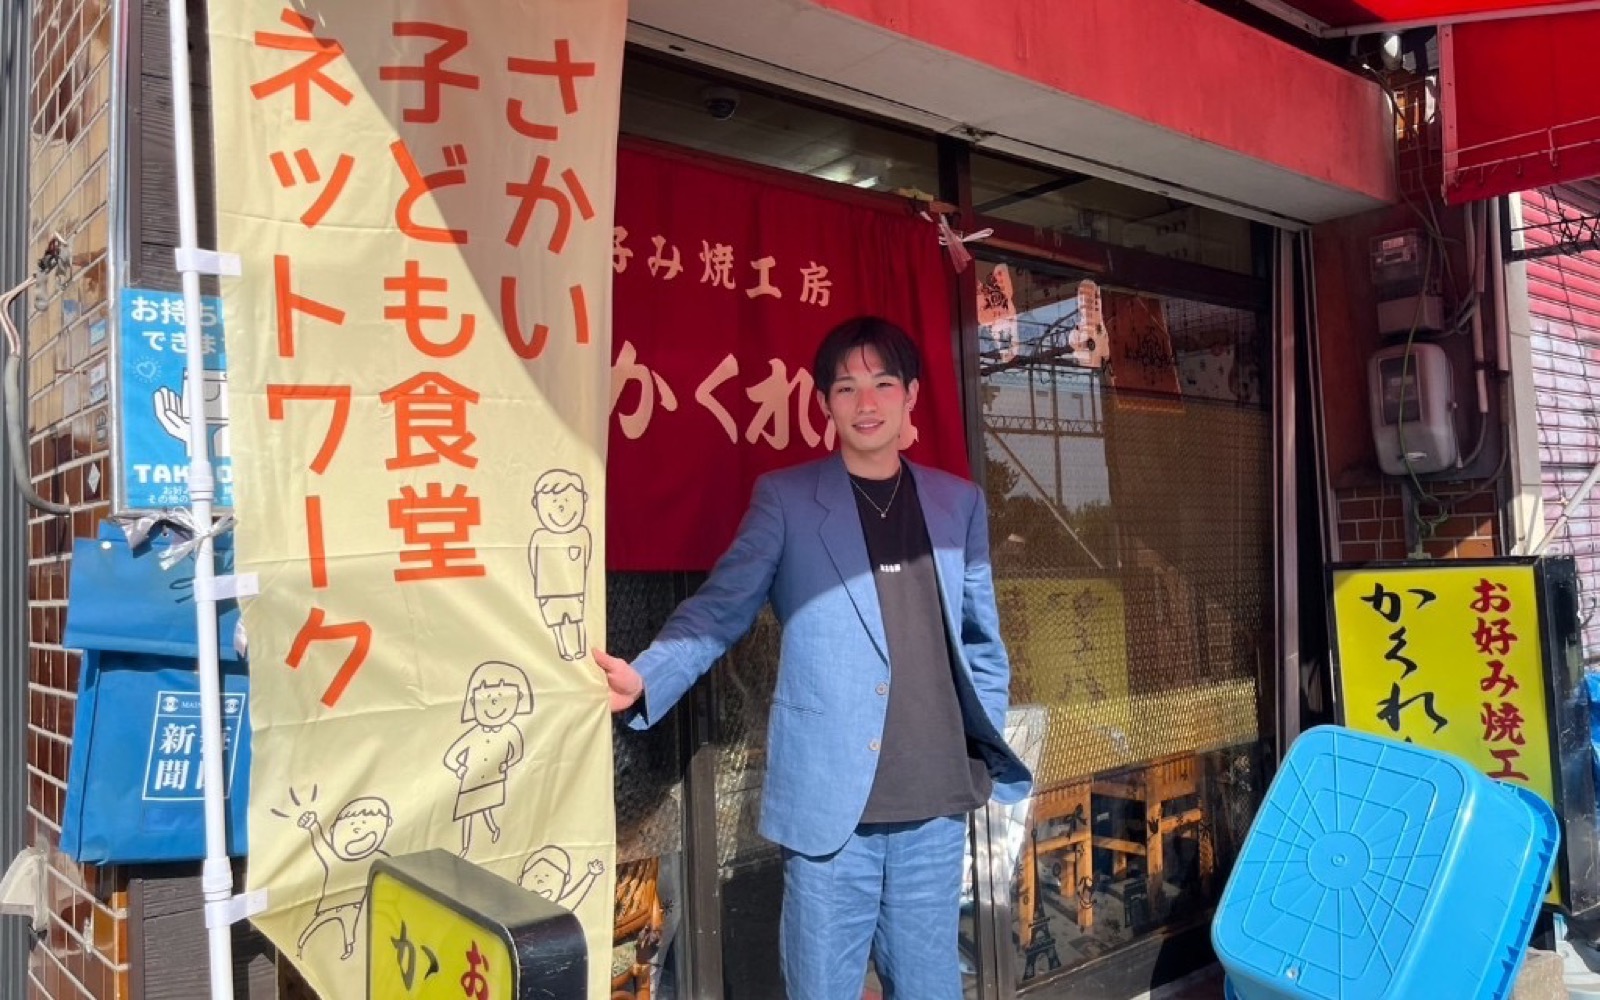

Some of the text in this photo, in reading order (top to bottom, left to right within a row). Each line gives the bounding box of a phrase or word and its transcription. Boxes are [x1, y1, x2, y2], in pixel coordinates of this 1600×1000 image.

[502, 39, 595, 360] さかい
[251, 8, 371, 707] ネットワーク
[379, 22, 486, 582] 子ども食堂
[609, 340, 919, 451] かくれ
[1360, 582, 1448, 742] かくれ
[1470, 578, 1529, 781] お好み焼工
[154, 723, 198, 791] 新聞
[390, 919, 440, 992] か
